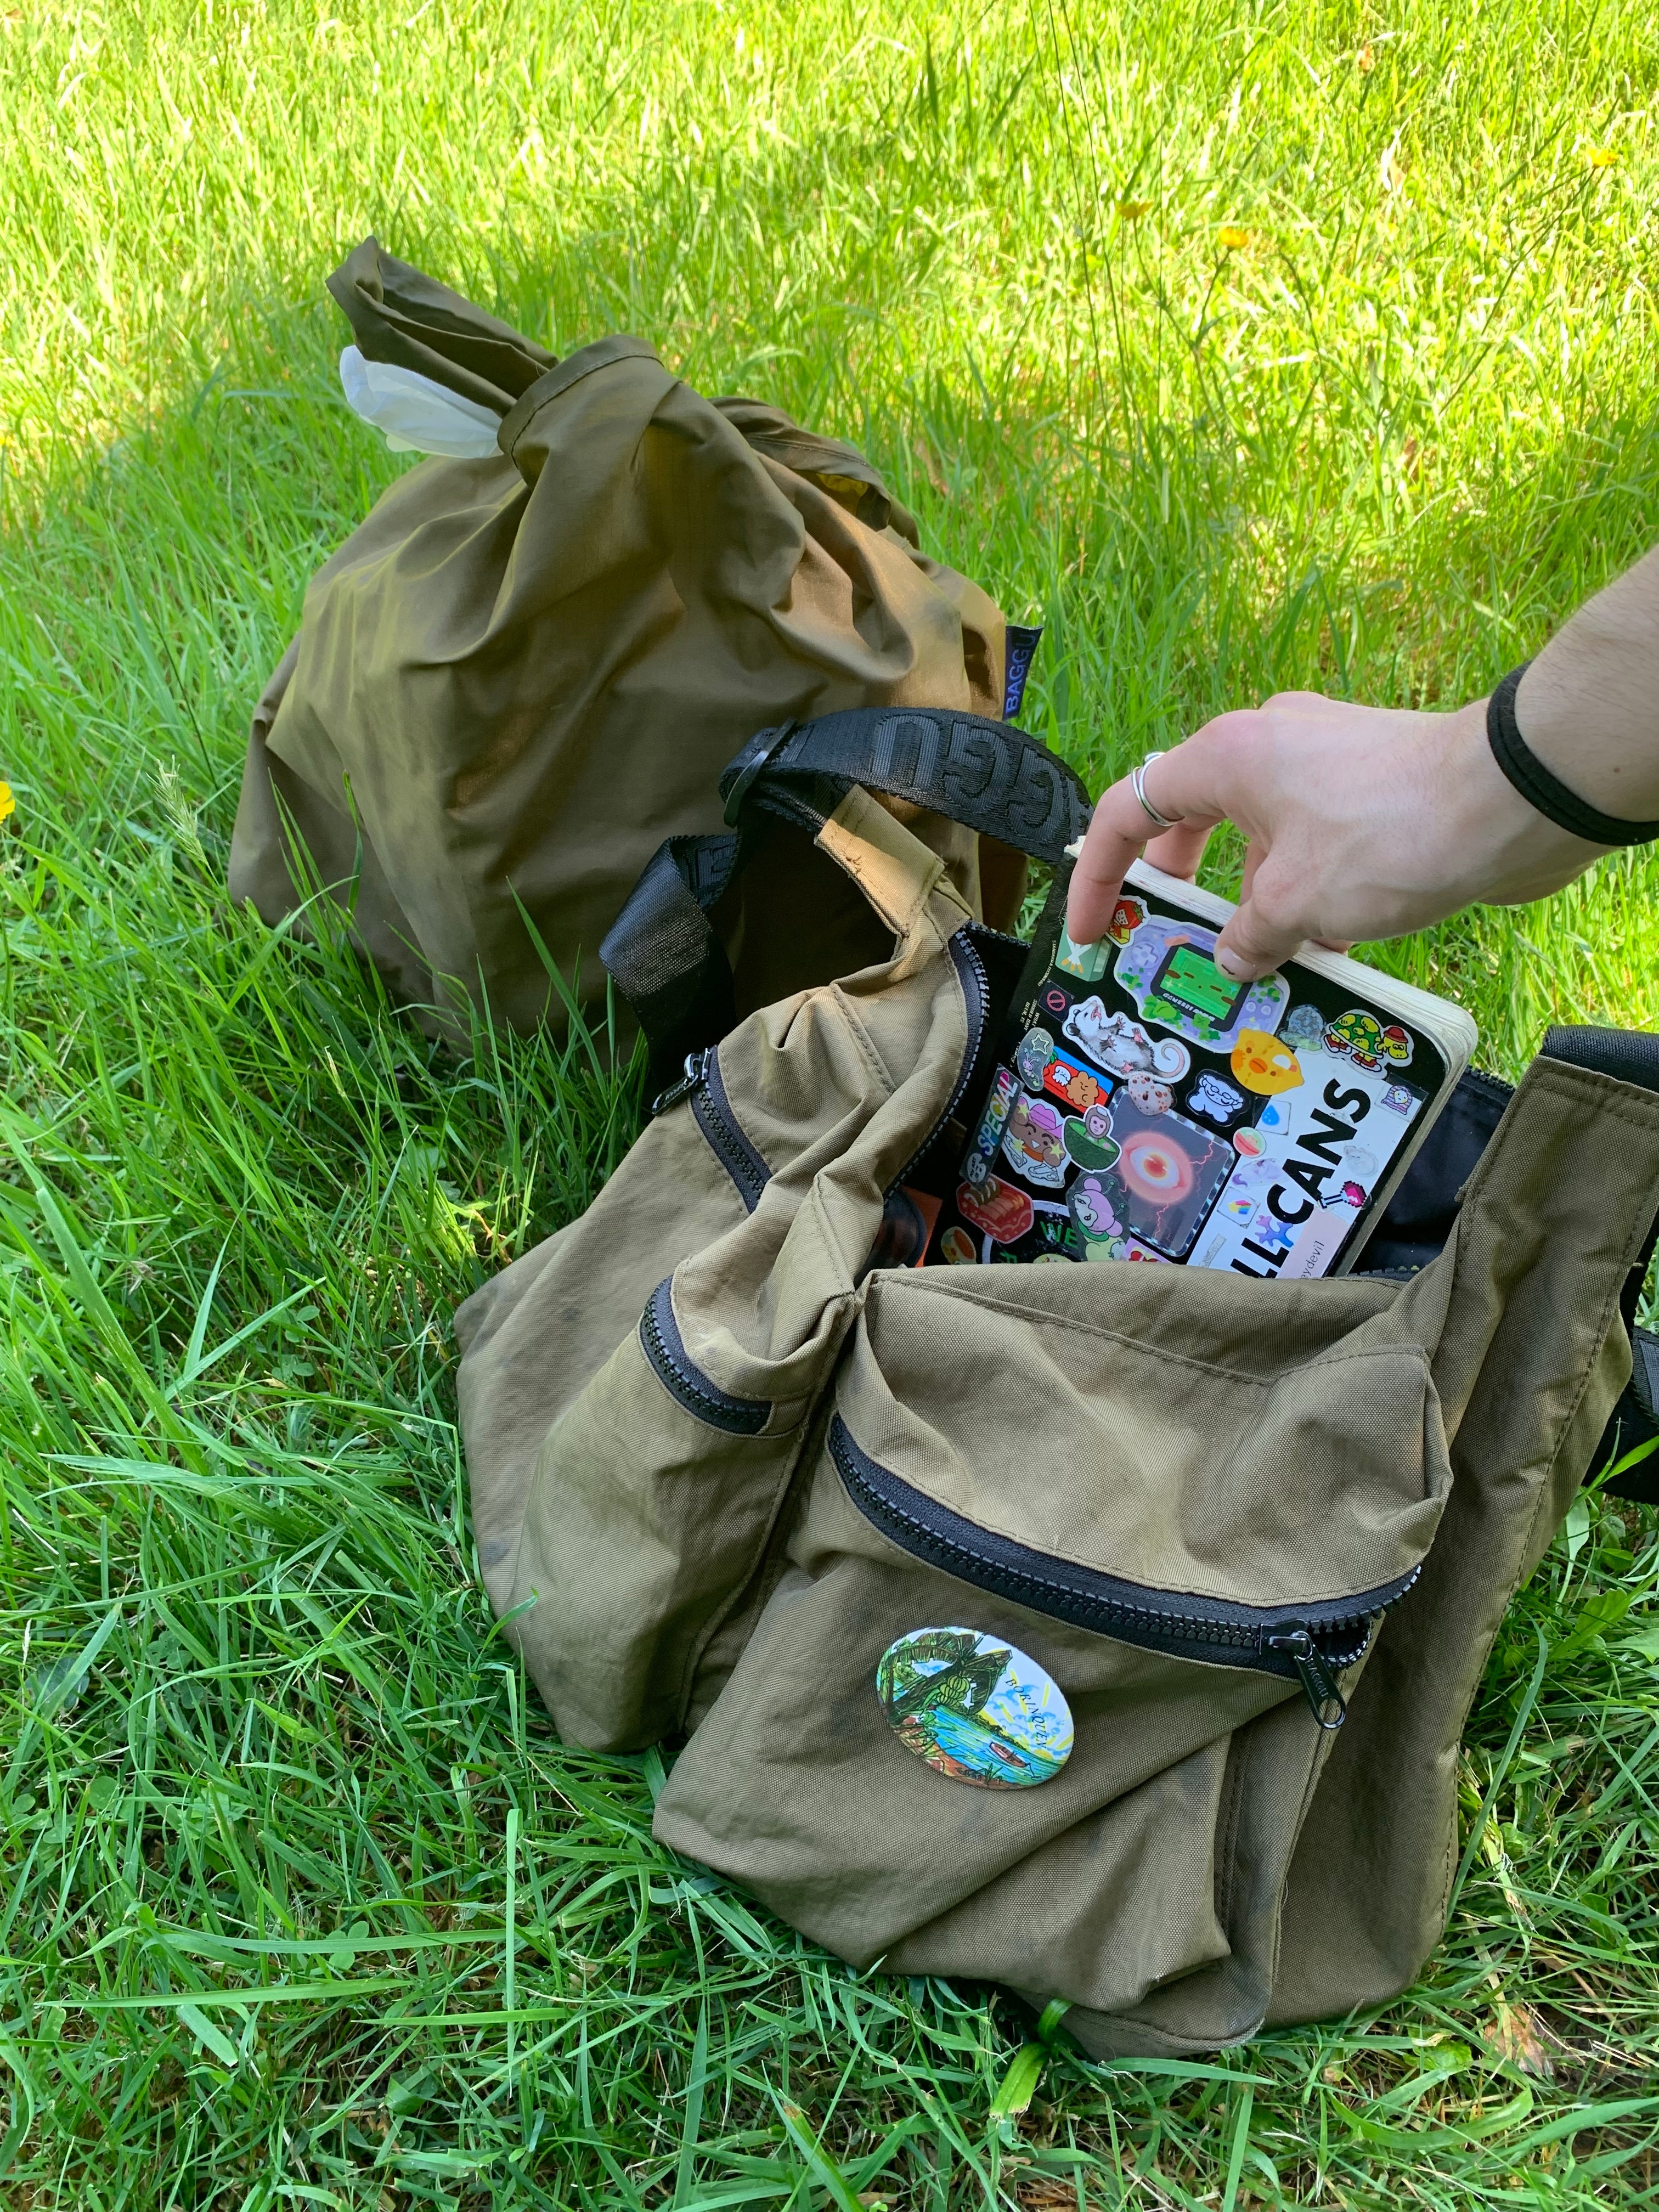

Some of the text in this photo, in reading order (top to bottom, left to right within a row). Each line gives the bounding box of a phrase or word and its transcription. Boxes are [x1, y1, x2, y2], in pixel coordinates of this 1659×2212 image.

[1006, 634, 1035, 713] BAGGU
[1032, 1012, 1040, 1027] WHAT
[978, 1076, 1018, 1156] SPECIAL
[1267, 1078, 1370, 1224] CANS
[1005, 1679, 1048, 1750] BORINQUEN
[1305, 1658, 1329, 1697] BAGGU
